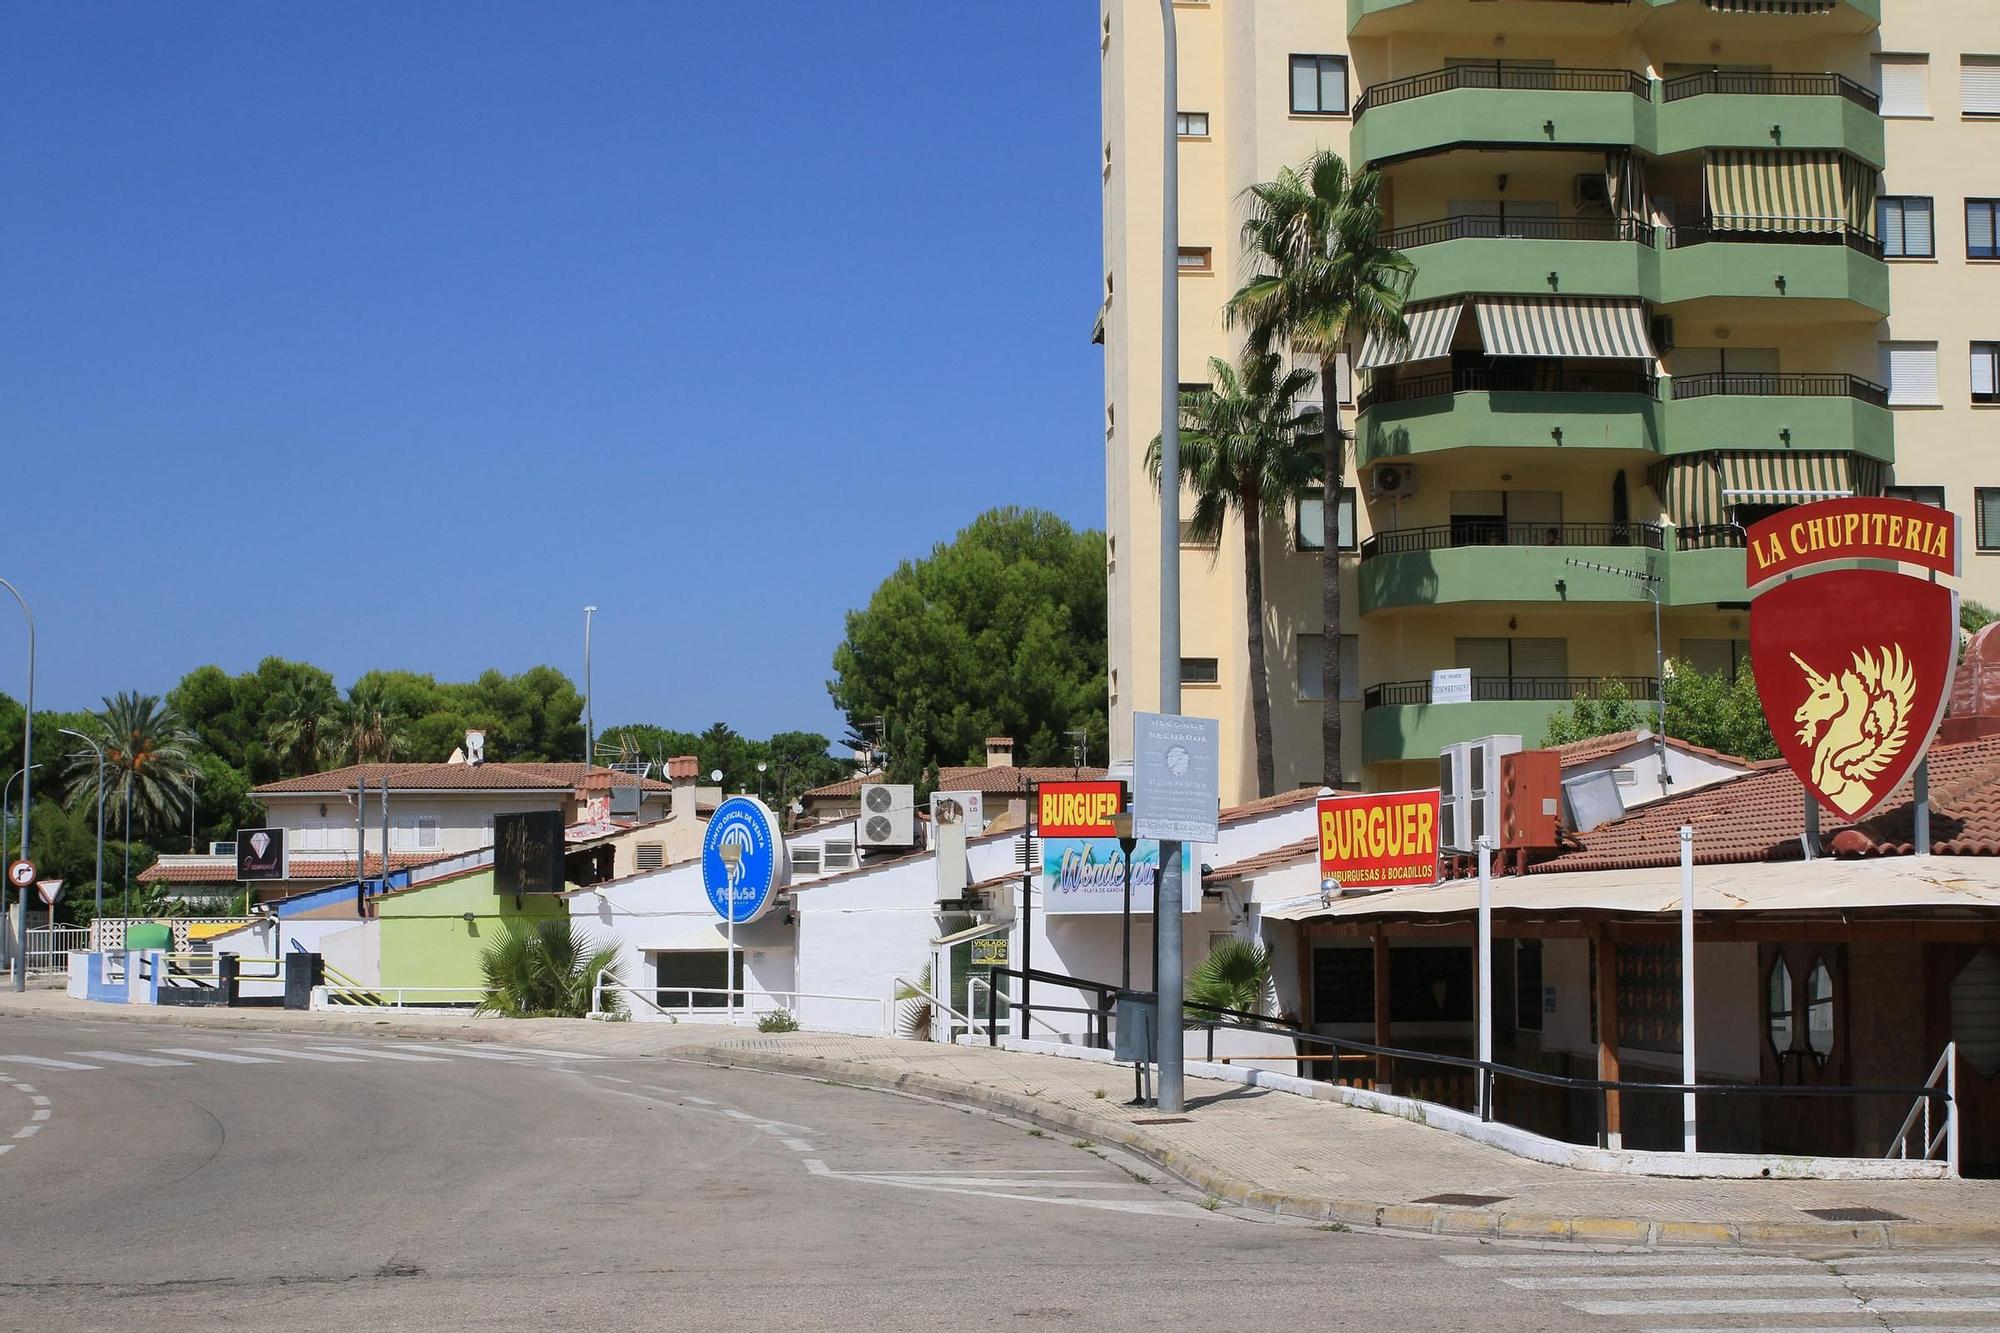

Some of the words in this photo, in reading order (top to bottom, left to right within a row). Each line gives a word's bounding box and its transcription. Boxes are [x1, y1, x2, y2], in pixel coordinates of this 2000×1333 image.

[1752, 532, 1787, 569] LA
[1790, 513, 1948, 559] CHUPITERIA
[1042, 793, 1118, 826] BURGUER
[710, 823, 723, 850] PUNTO
[722, 811, 744, 824] OFICIAL
[744, 813, 753, 823] DE
[752, 821, 764, 848] VENTA
[1321, 803, 1433, 860] BURGUER
[1322, 868, 1380, 883] HAMBURGUESAS
[1382, 867, 1387, 880] &
[1388, 865, 1433, 880] BOCADILLOS
